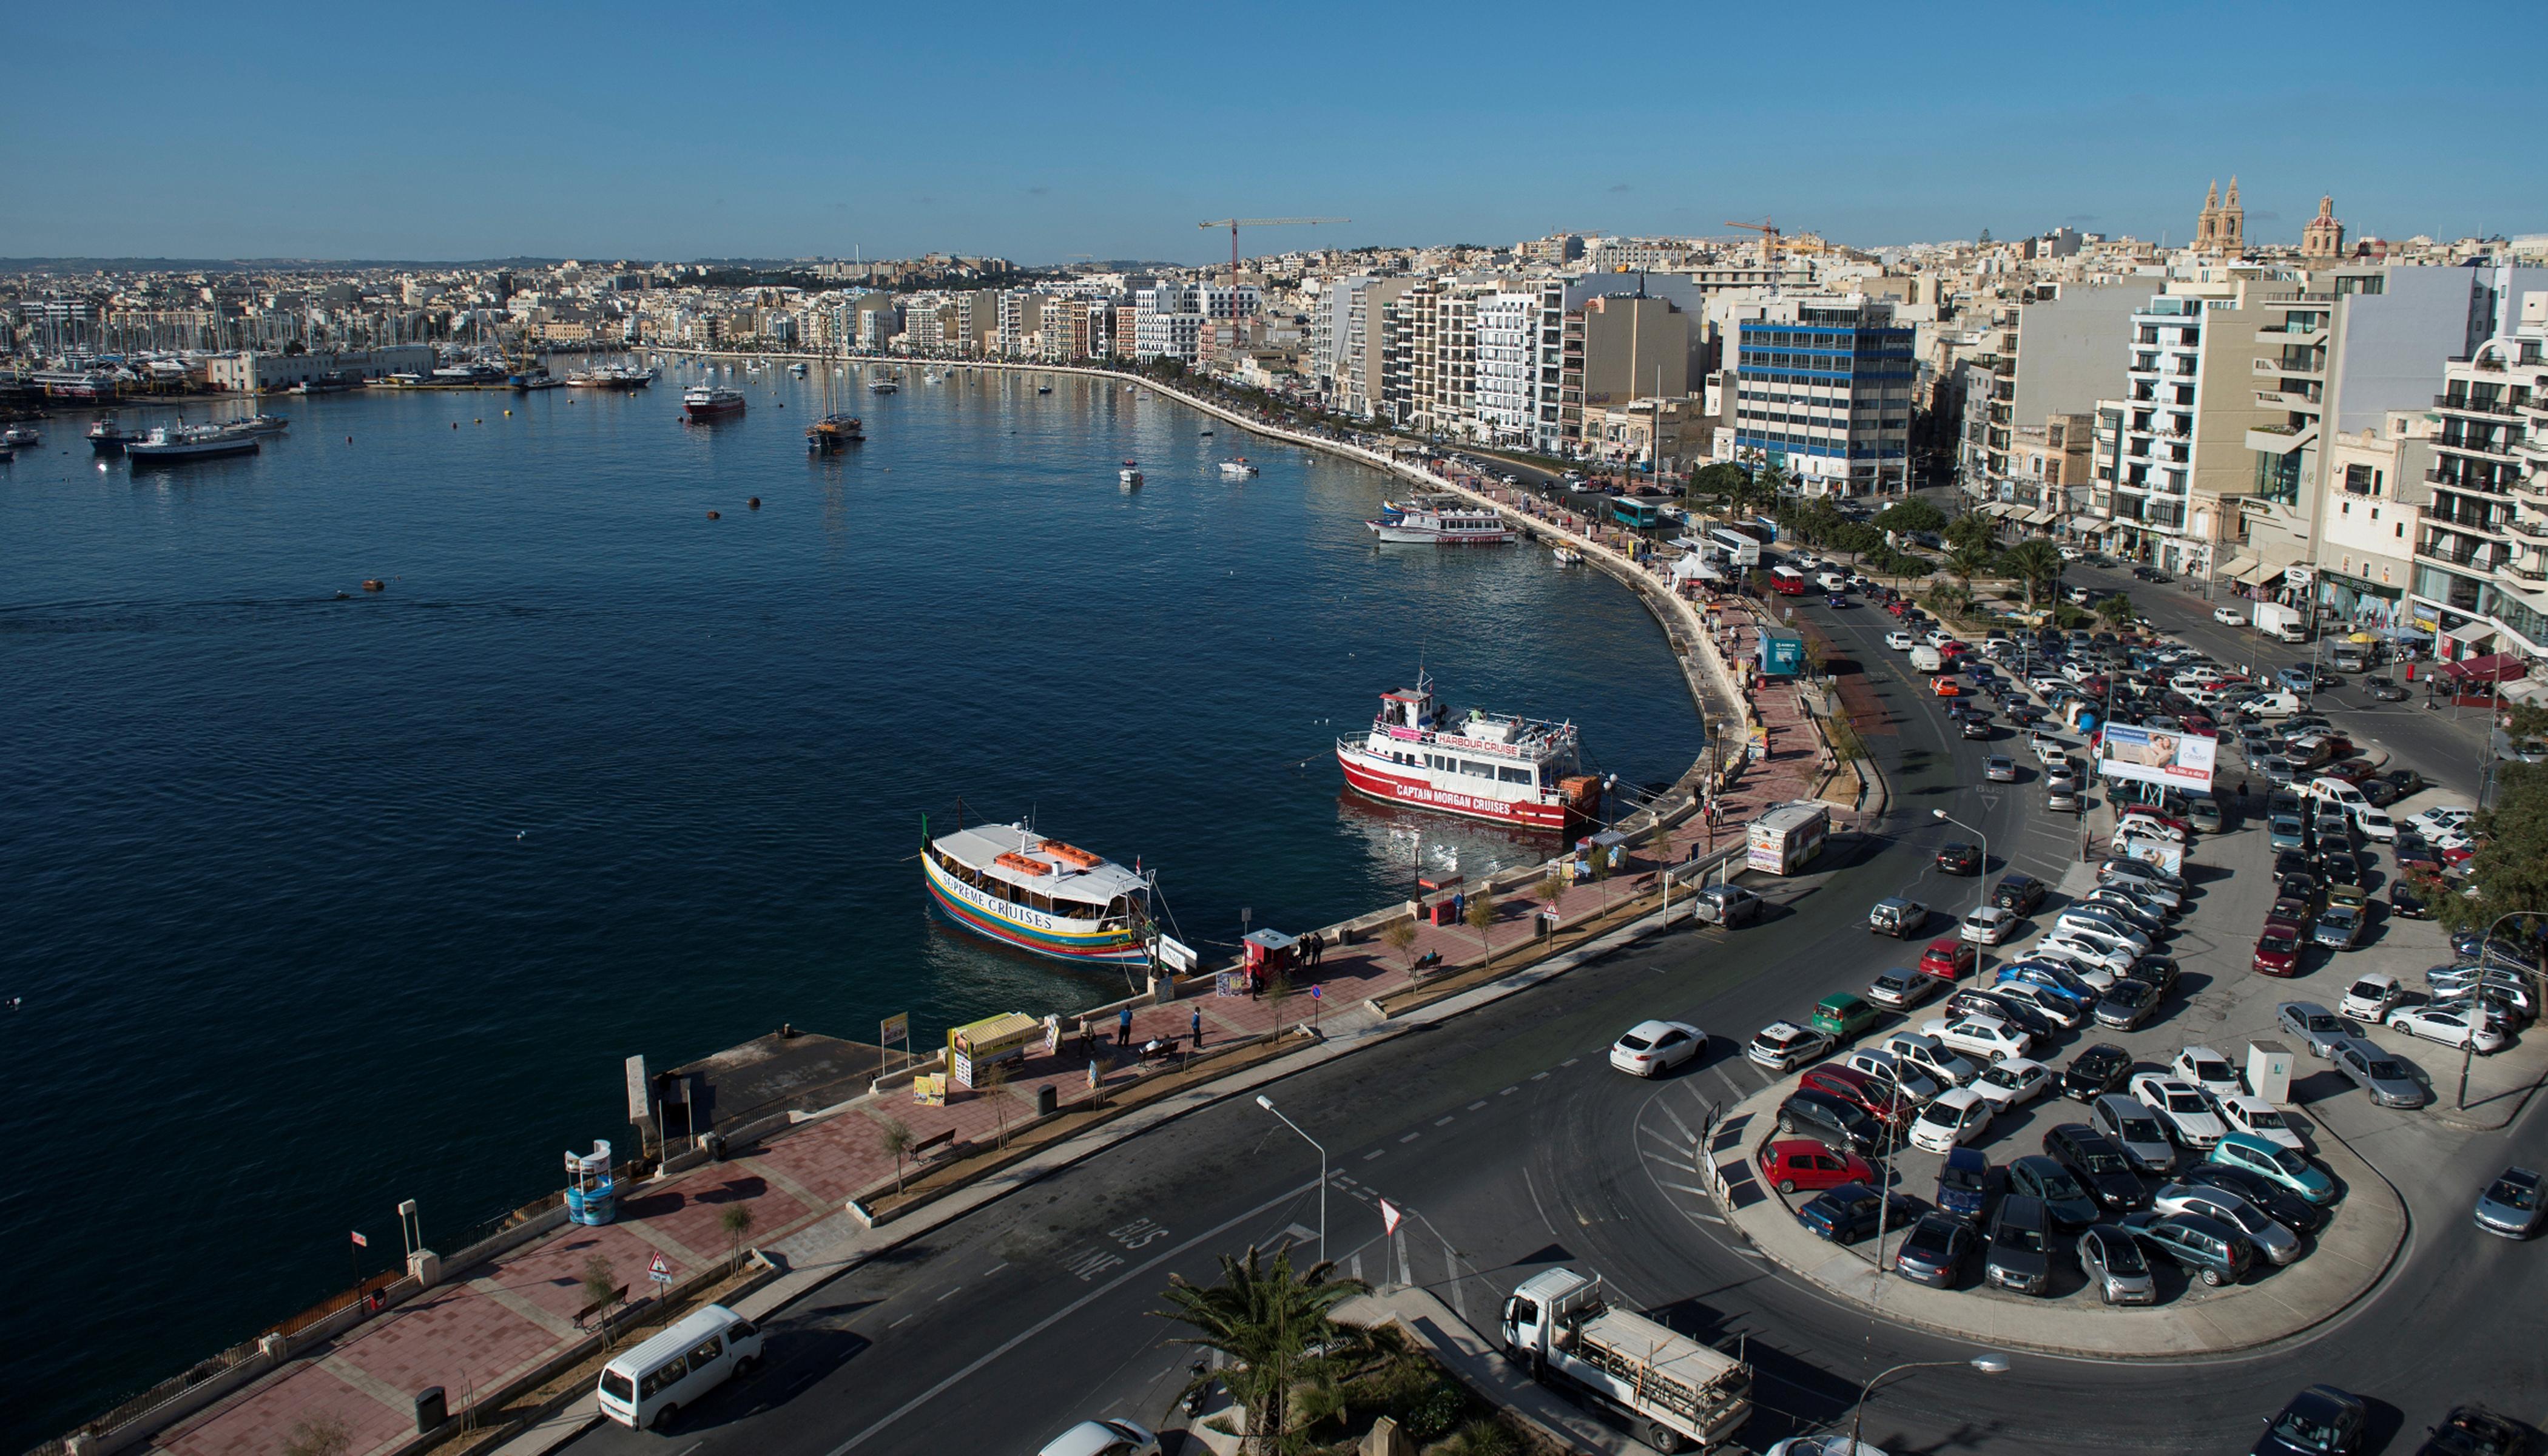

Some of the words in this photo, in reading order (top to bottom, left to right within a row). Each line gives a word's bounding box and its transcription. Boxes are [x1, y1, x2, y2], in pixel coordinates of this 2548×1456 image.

[1439, 734, 1482, 749] HARBOUR
[1484, 741, 1518, 755] CRUISE
[1396, 784, 1432, 801] CAPTAIN
[1434, 790, 1471, 808] MORGAN
[1473, 798, 1511, 815] CRUISES
[1975, 784, 2004, 795] BUS
[943, 874, 985, 907] SUPREME
[988, 898, 1052, 930] CRUISES
[1770, 1027, 1787, 1036] 36
[1107, 1217, 1170, 1250] BUS
